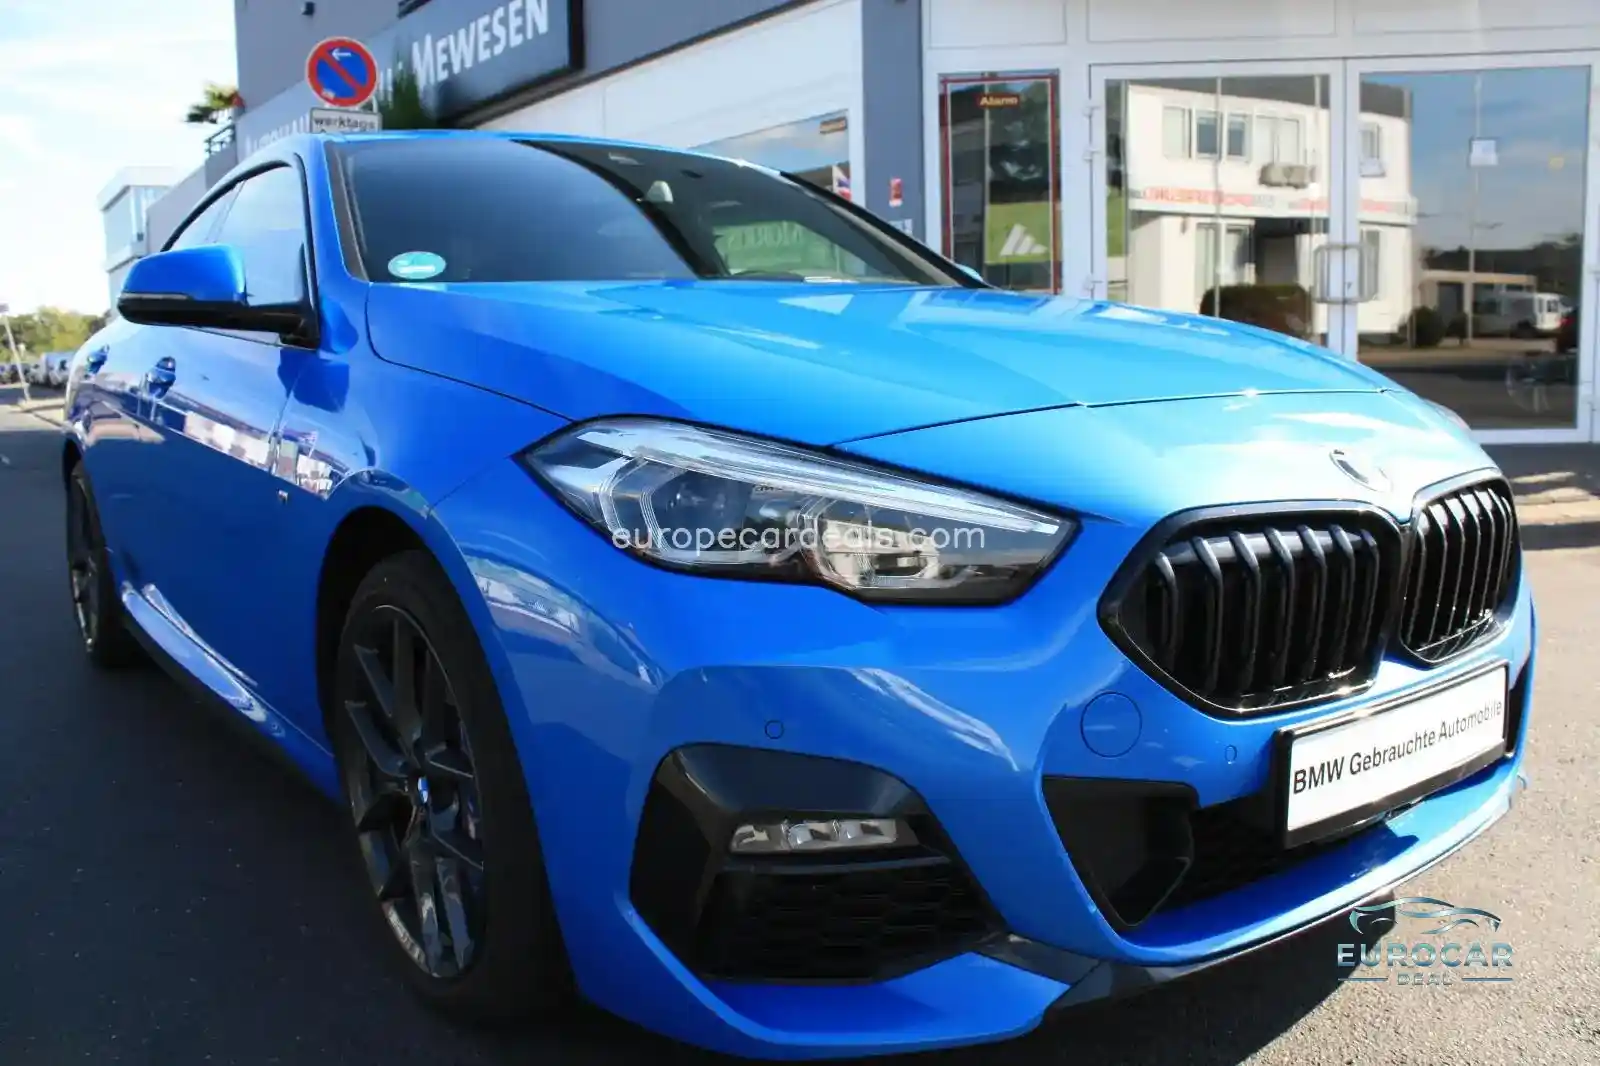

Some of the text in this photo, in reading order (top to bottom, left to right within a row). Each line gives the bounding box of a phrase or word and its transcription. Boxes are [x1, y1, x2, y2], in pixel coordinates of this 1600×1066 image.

[314, 114, 376, 130] werktags
[1293, 700, 1503, 795] BMW Gebrauchte Automobile
